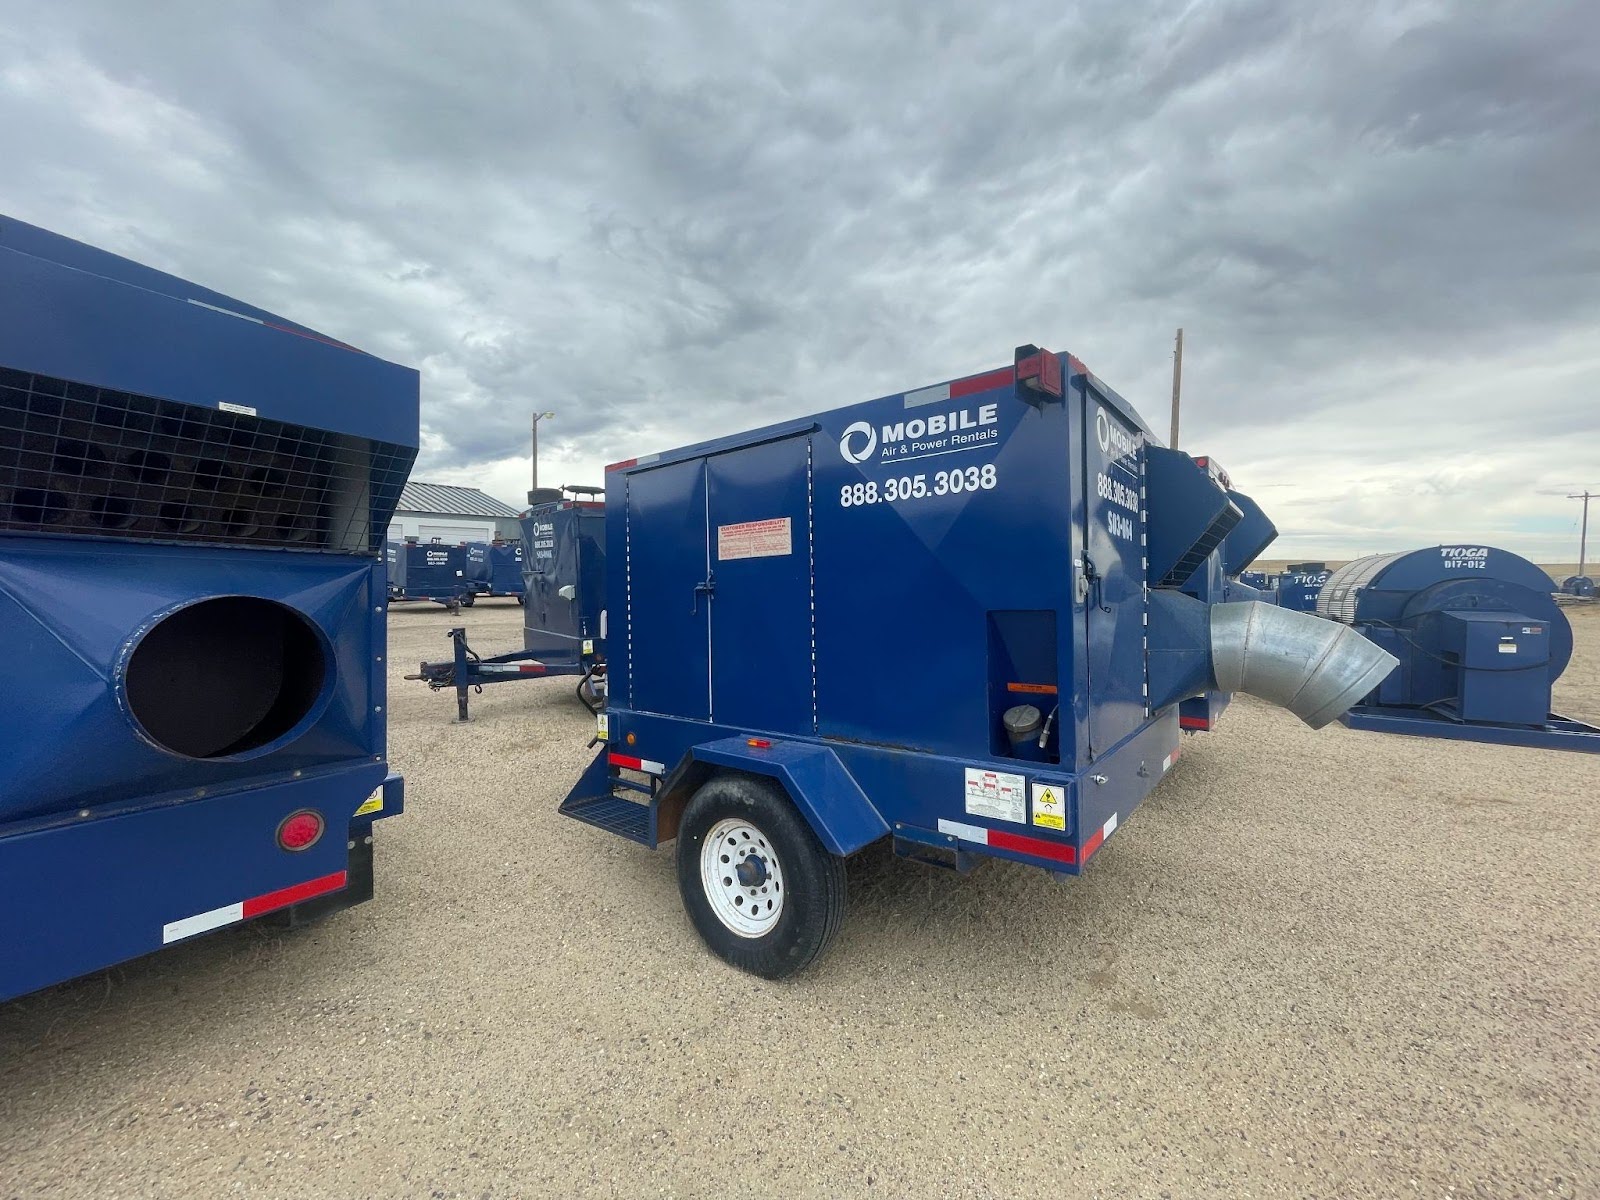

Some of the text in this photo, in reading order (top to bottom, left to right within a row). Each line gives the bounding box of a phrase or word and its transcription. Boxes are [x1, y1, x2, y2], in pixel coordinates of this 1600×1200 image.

[882, 403, 998, 444] MOBILE
[882, 428, 998, 457] Air & Power Rentals
[1109, 425, 1138, 461] MOBILE
[840, 463, 997, 508] 888.305.3038
[1440, 548, 1488, 557] TIOGA
